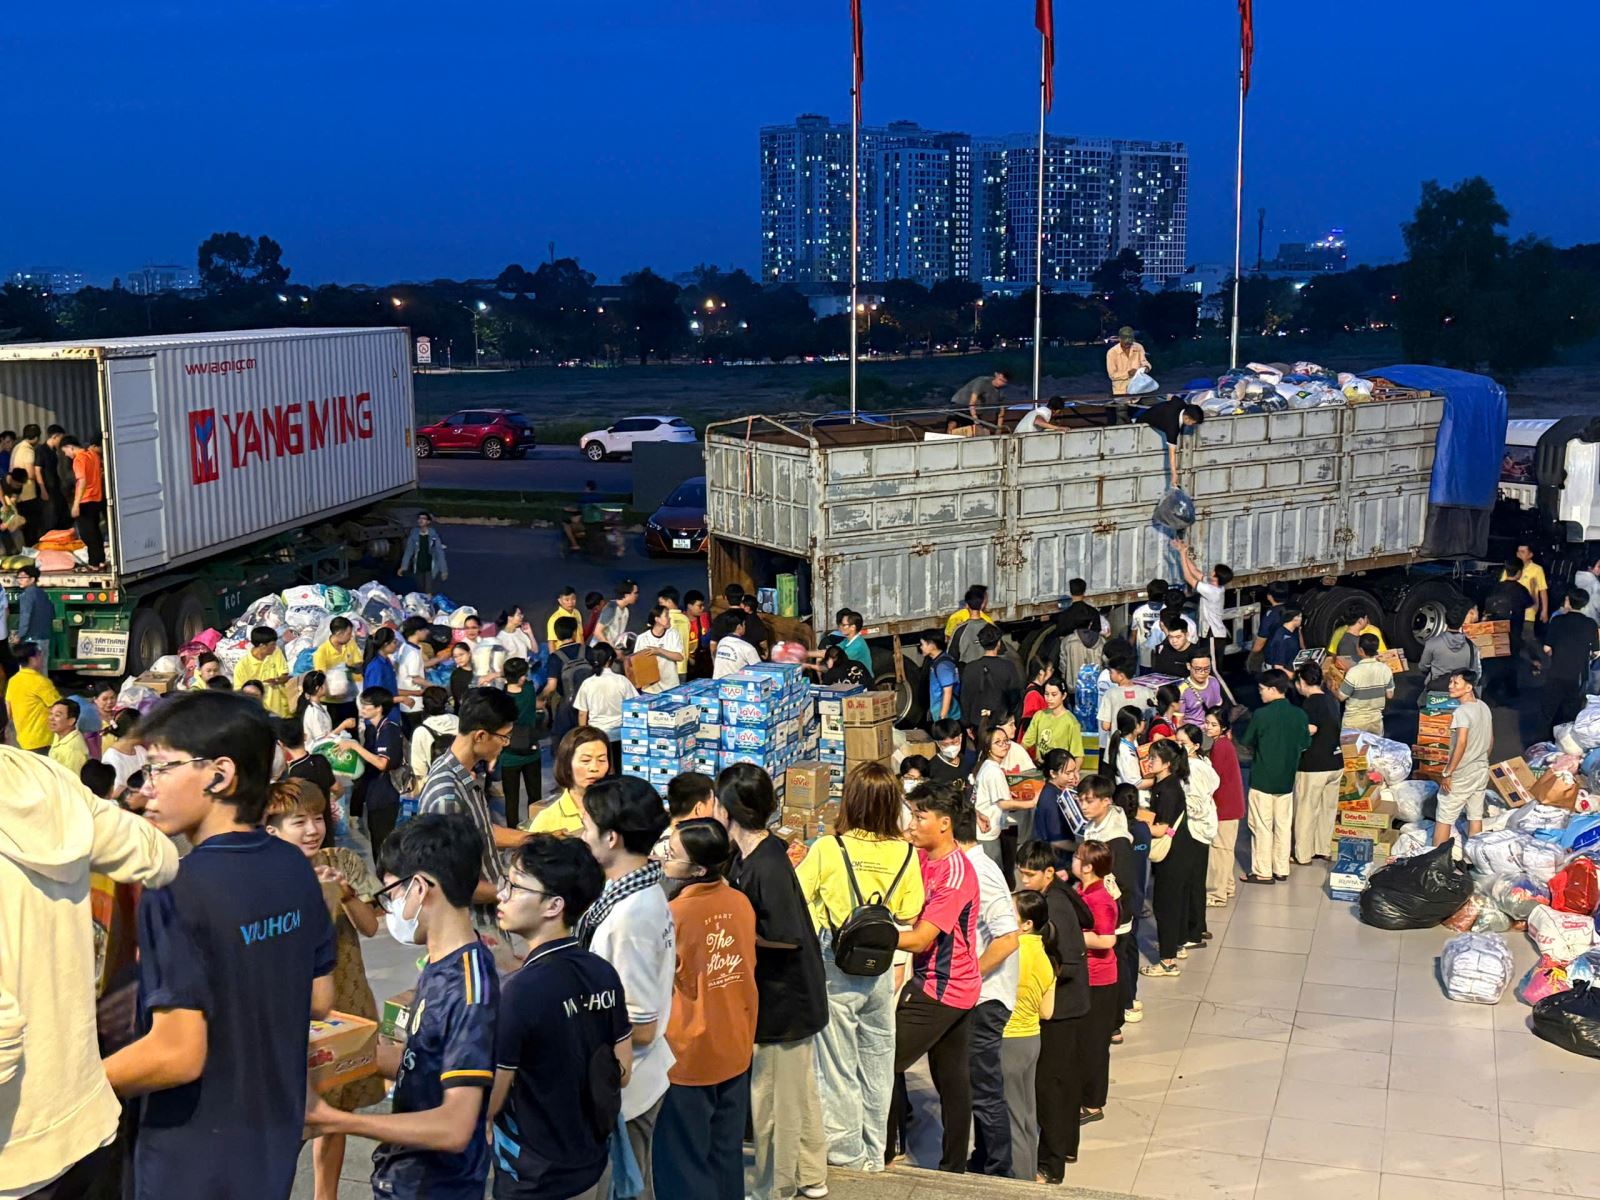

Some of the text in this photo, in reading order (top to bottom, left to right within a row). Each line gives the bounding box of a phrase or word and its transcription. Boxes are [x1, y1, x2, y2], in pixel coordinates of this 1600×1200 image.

[222, 391, 374, 469] YANG MING
[706, 929, 735, 953] The
[707, 951, 743, 976] Story
